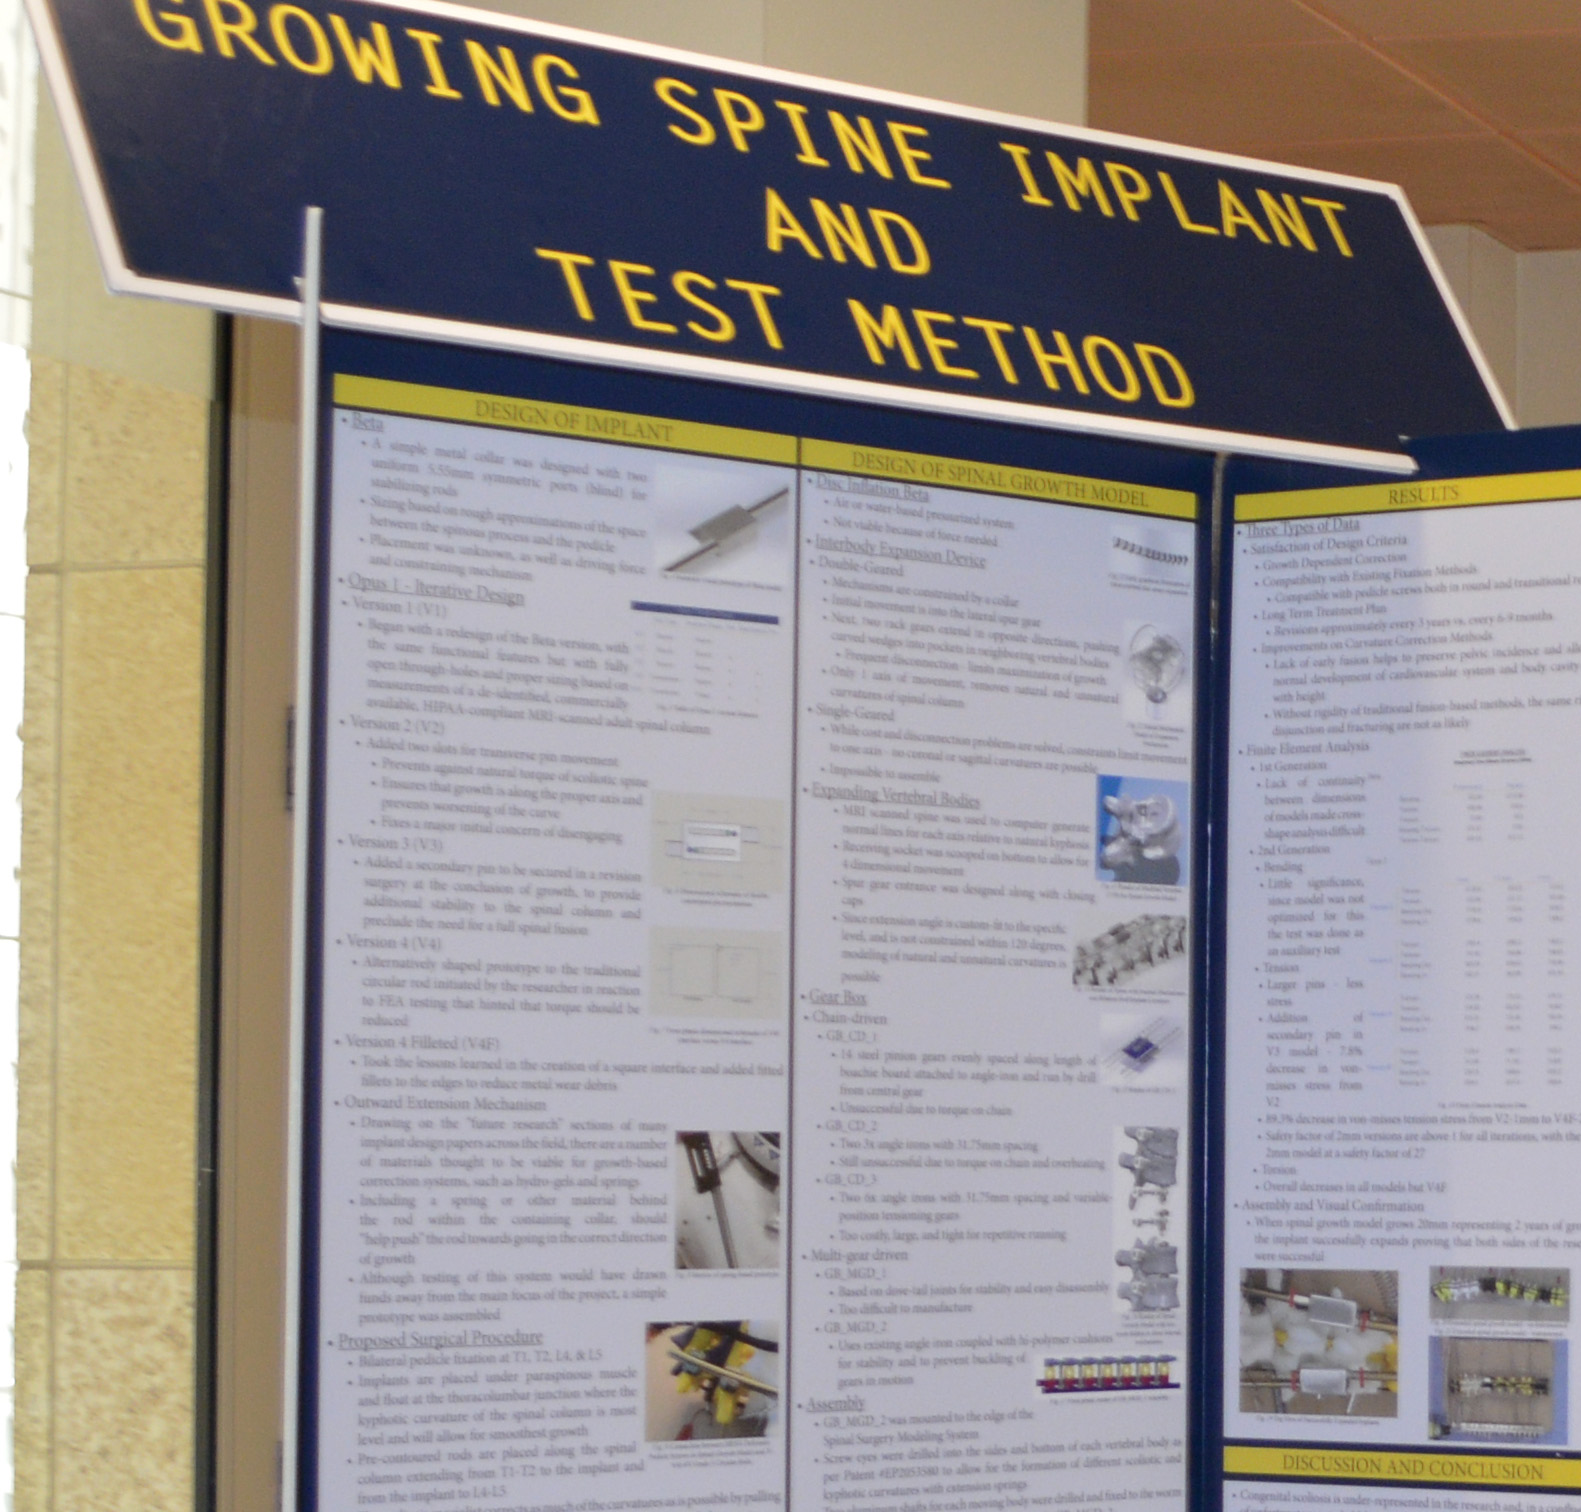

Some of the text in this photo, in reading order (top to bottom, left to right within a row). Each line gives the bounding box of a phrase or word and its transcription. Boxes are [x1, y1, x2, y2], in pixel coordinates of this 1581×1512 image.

[132, 0, 1356, 257] GROWING SPINE IMPLANT
[766, 188, 931, 275] AND
[536, 248, 1195, 408] TEST METHOD
[352, 413, 383, 432] Beta
[475, 399, 673, 442] DESIGN OF IMPLANT
[817, 472, 929, 503] Disc Inflation Beta
[852, 451, 1149, 508] DESIGN OF SPINAL GROWTH MODEL
[1389, 485, 1459, 506] RESULTS
[1245, 516, 1360, 538] Three Types of Data
[815, 534, 986, 570] Interbody Expansion Device
[1251, 535, 1407, 555] Satisfaction of Design Criteria
[819, 555, 904, 577] Double-Geared
[348, 573, 525, 607] Opus 1 Iterative Design
[352, 595, 446, 618] Version 1 (V1)
[816, 704, 895, 721] Single-Geared
[350, 714, 445, 735] Version 2 (V2)
[1246, 740, 1370, 756] Finite Element Analysis
[812, 783, 981, 810] Expanding Vertebral Bodies
[348, 833, 443, 853] Version 3 (V3)
[347, 933, 441, 952] Version 4 (V4)
[809, 988, 867, 1007] Gear Box
[813, 1010, 888, 1025] Chain-driven
[346, 1034, 499, 1051] Version 4 Filleted (V4F)
[344, 1095, 546, 1111] Outward Extension Mechanism
[1242, 1199, 1424, 1213] Assembly and Visual Confirmation
[339, 1329, 543, 1351] Proposed Surgical Procedure
[806, 1395, 864, 1414] Assembly
[1283, 1455, 1543, 1483] DISCUSSION AND CONCLUSION
